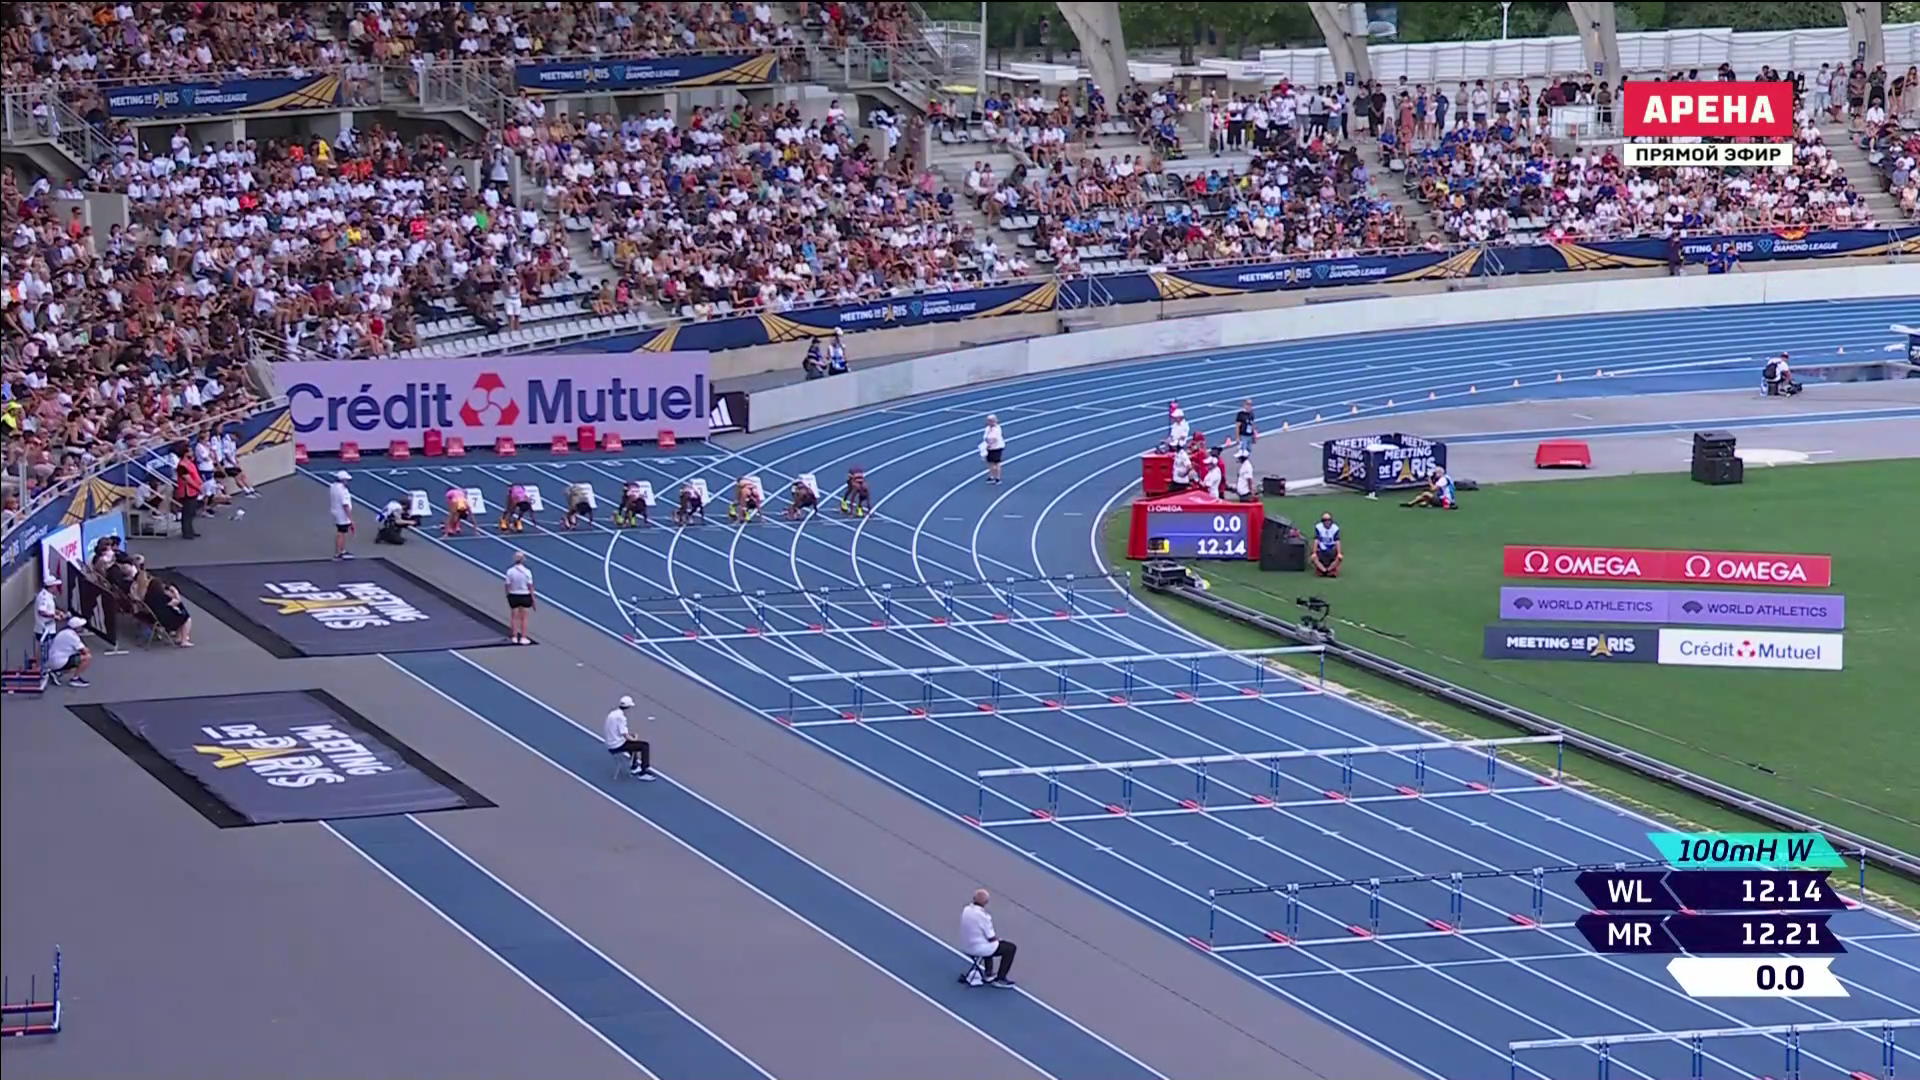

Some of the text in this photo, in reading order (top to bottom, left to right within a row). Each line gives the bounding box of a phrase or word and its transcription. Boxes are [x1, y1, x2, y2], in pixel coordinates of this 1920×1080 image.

[540, 70, 574, 81] MEETING
[583, 66, 610, 83] PARIS
[626, 71, 655, 80] DIAMOND
[655, 69, 680, 78] LEAGUE
[110, 94, 144, 107] MEETING
[153, 90, 179, 108] PARIS
[194, 93, 248, 104] DIAMOND LEAGUE
[1773, 243, 1808, 252] DIAMOND
[1809, 242, 1839, 251] LEAGUE
[1238, 272, 1274, 282] MEETING
[1284, 267, 1312, 283] PARIS
[1329, 269, 1360, 278] DIAMOND
[1360, 267, 1388, 277] LEAGUE
[840, 310, 873, 322] MEETING
[882, 303, 907, 321] PARIS
[923, 305, 951, 316] DIAMOND
[951, 302, 976, 312] LEAGUE
[285, 374, 705, 433] Crédit Mutuel
[1331, 445, 1363, 461] MEETING
[1384, 446, 1432, 460] MEETING
[1337, 457, 1366, 480] PARIS
[1379, 456, 1436, 482] DE PARIS
[418, 500, 424, 510] 8
[472, 497, 478, 508] 7
[1213, 516, 1241, 532] 0.0
[1197, 538, 1247, 555] 12.14
[1554, 555, 1641, 577] OMEGA
[1717, 560, 1807, 582] OMEGA
[338, 582, 431, 622] MEETING
[1538, 600, 1653, 612] WORLD ATHLETICS
[1708, 603, 1827, 617] WORLD ATHLETICS
[1506, 634, 1636, 656] MEETING DE PARIS
[1680, 640, 1821, 660] Crédit Mutuel
[289, 724, 393, 775] MEETING
